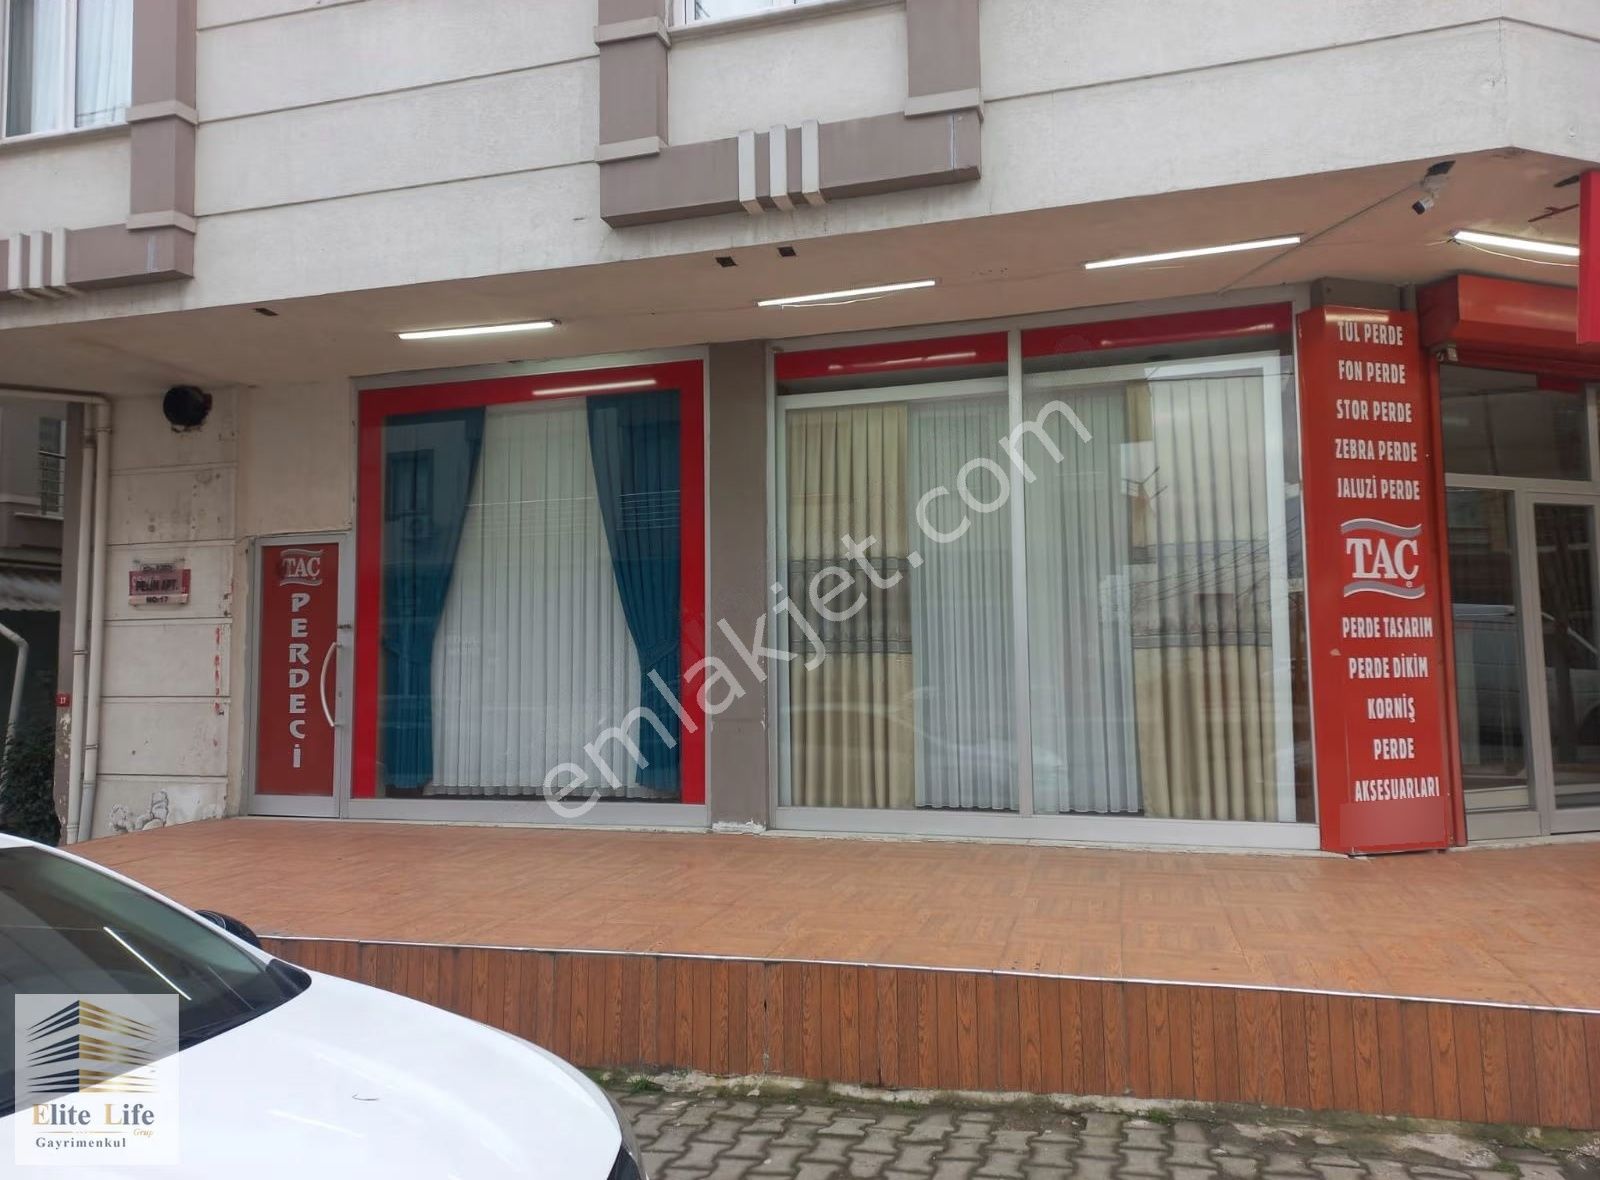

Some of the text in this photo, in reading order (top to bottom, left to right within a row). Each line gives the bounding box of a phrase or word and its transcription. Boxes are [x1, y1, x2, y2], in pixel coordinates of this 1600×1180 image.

[1364, 323, 1403, 346] PERDE
[1338, 360, 1406, 384] FON PERDE
[1336, 399, 1412, 423] STOR PERDE
[1335, 438, 1418, 462] ZEBRA PERDE
[1381, 479, 1420, 500] PERDE
[281, 556, 321, 580] TAÇ
[1345, 538, 1419, 588] TAÇ
[1342, 617, 1433, 638] PERDE TASARIM
[1349, 653, 1429, 679] PERDE DİKİM
[288, 593, 311, 768] PERDECİ
[1367, 693, 1416, 723] KORNİŞ
[1373, 738, 1415, 760] PERDE
[1355, 777, 1440, 802] AKSESUARLARI
